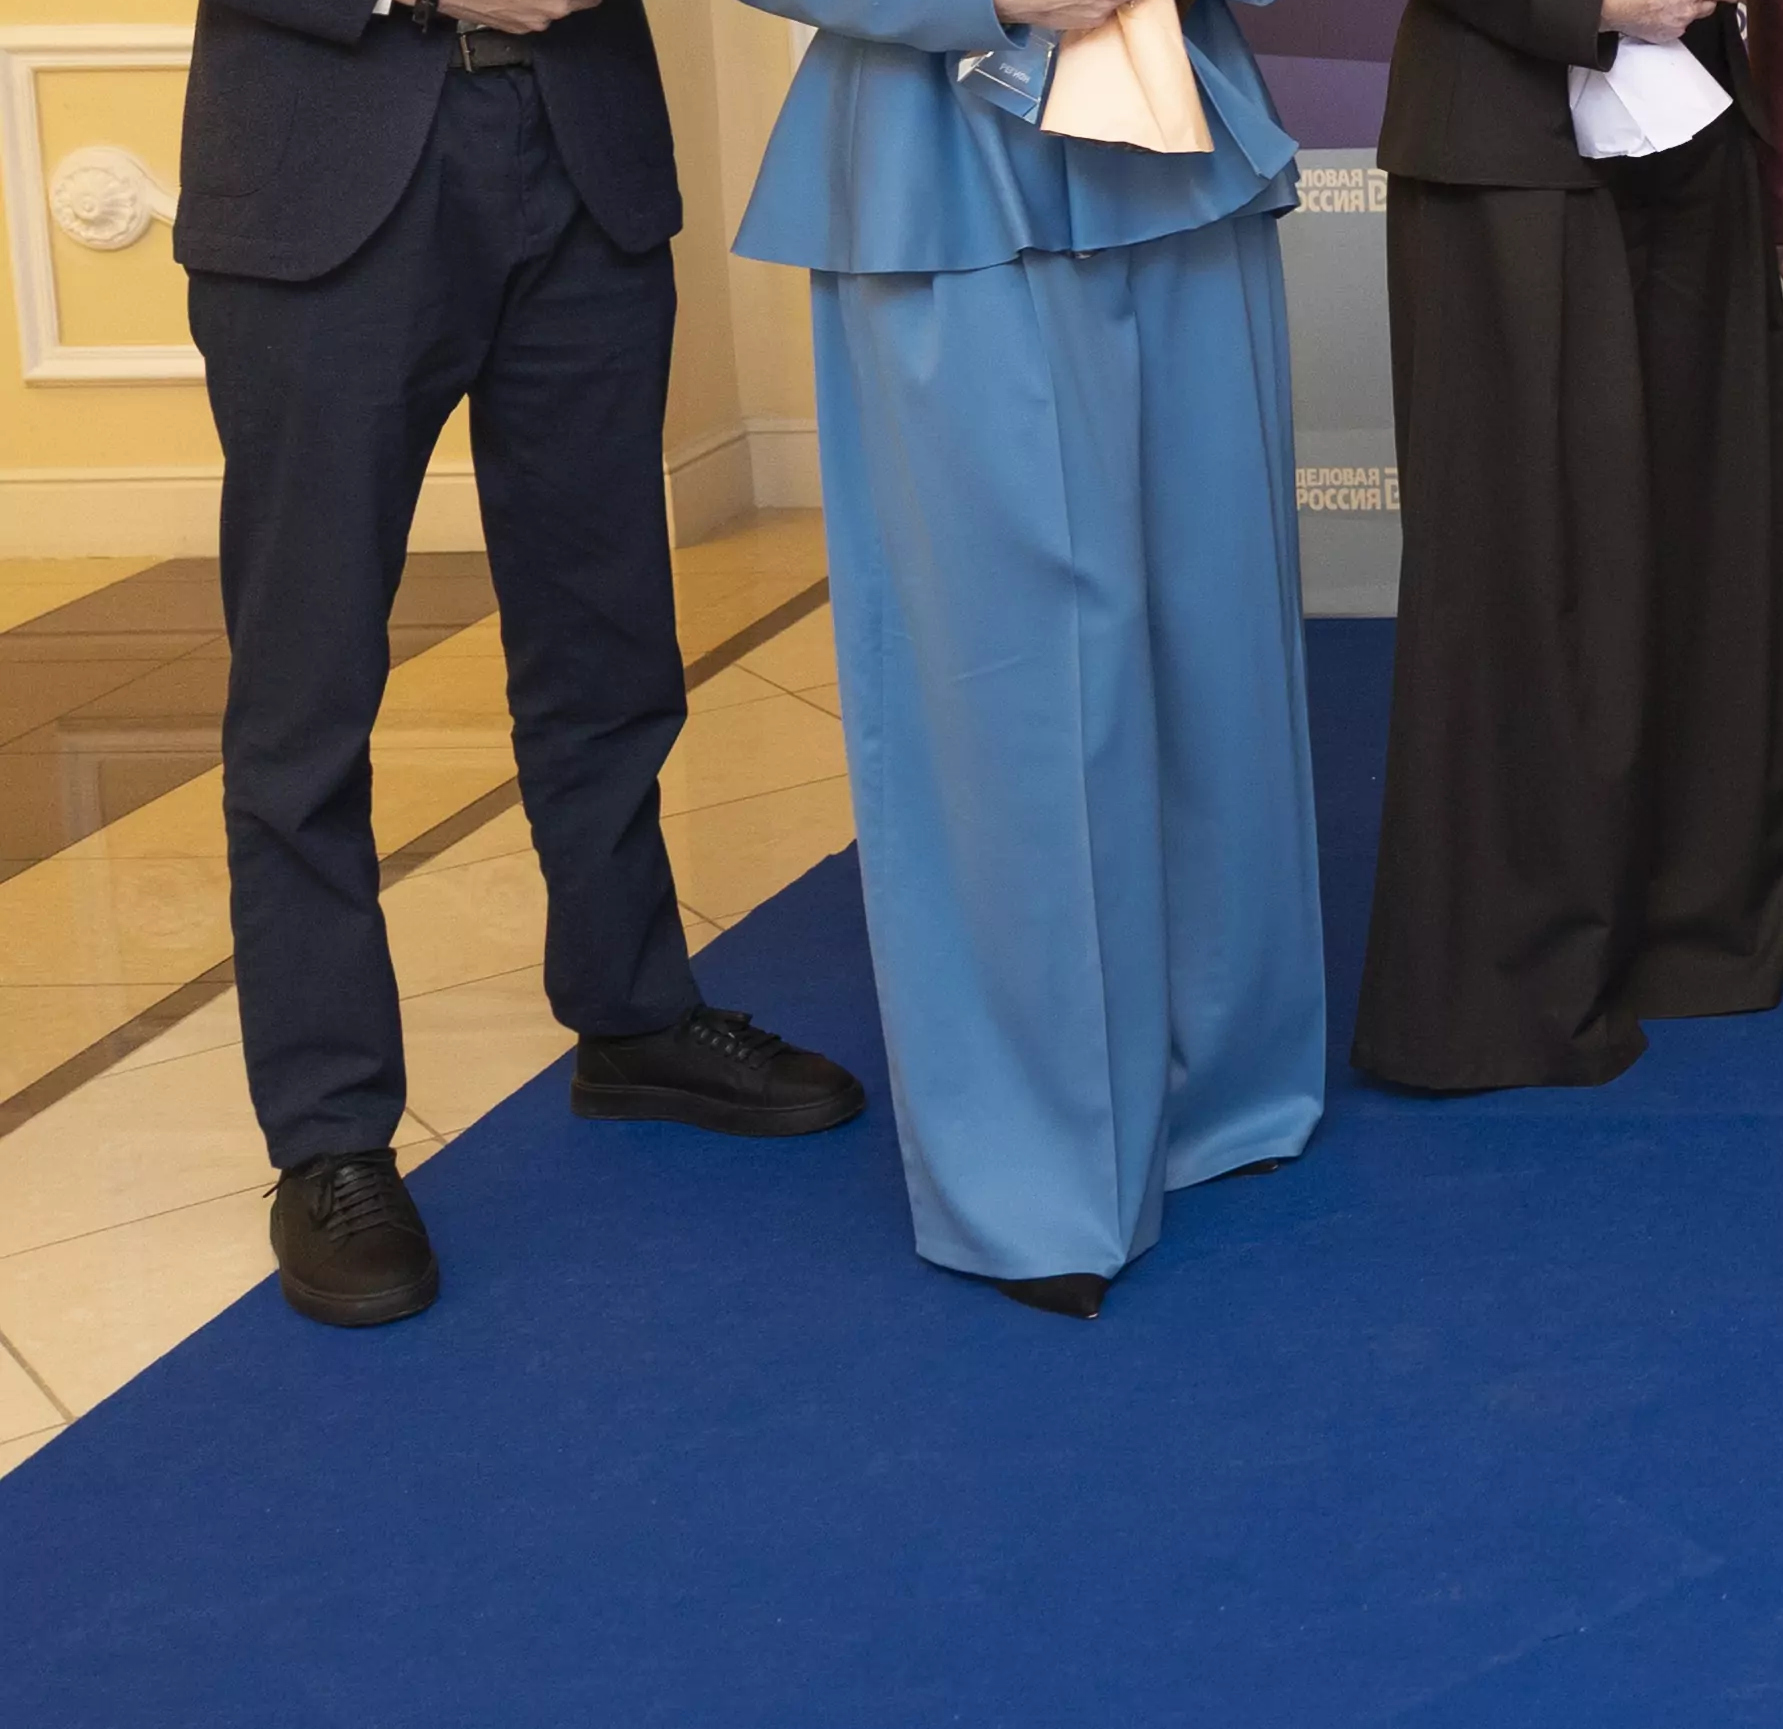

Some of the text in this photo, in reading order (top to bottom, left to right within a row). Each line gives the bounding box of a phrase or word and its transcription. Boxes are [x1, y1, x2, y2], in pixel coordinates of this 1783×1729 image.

[1299, 169, 1363, 187] ЛОВАЯ
[1296, 189, 1365, 213] ОССИЯ
[1295, 468, 1380, 487] ДЕЛОВАЯ
[1296, 489, 1381, 511] РОССИЯ
